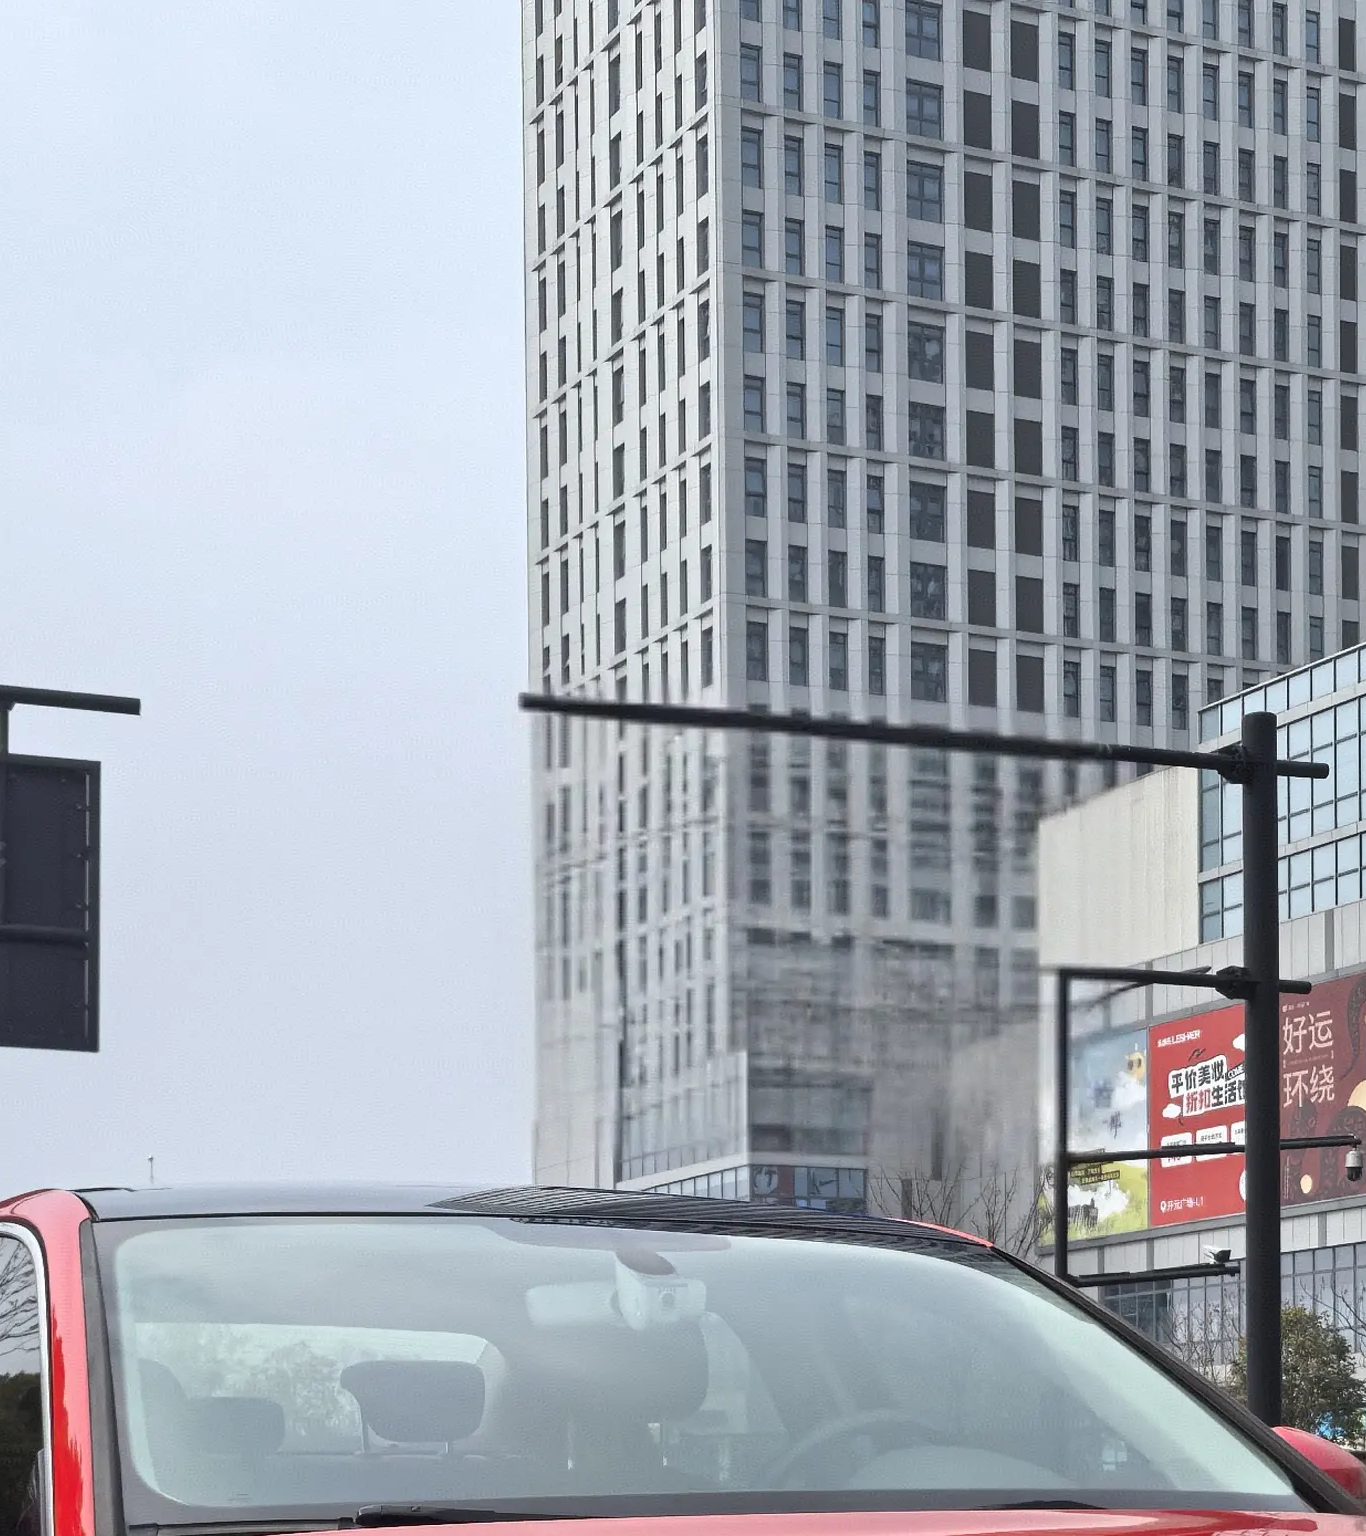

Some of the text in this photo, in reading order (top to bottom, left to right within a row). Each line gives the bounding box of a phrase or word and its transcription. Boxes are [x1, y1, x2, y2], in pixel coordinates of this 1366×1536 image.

[1282, 1010, 1333, 1056] 好运
[1171, 1059, 1224, 1094] 平价美妆
[1282, 1063, 1335, 1108] 环绕
